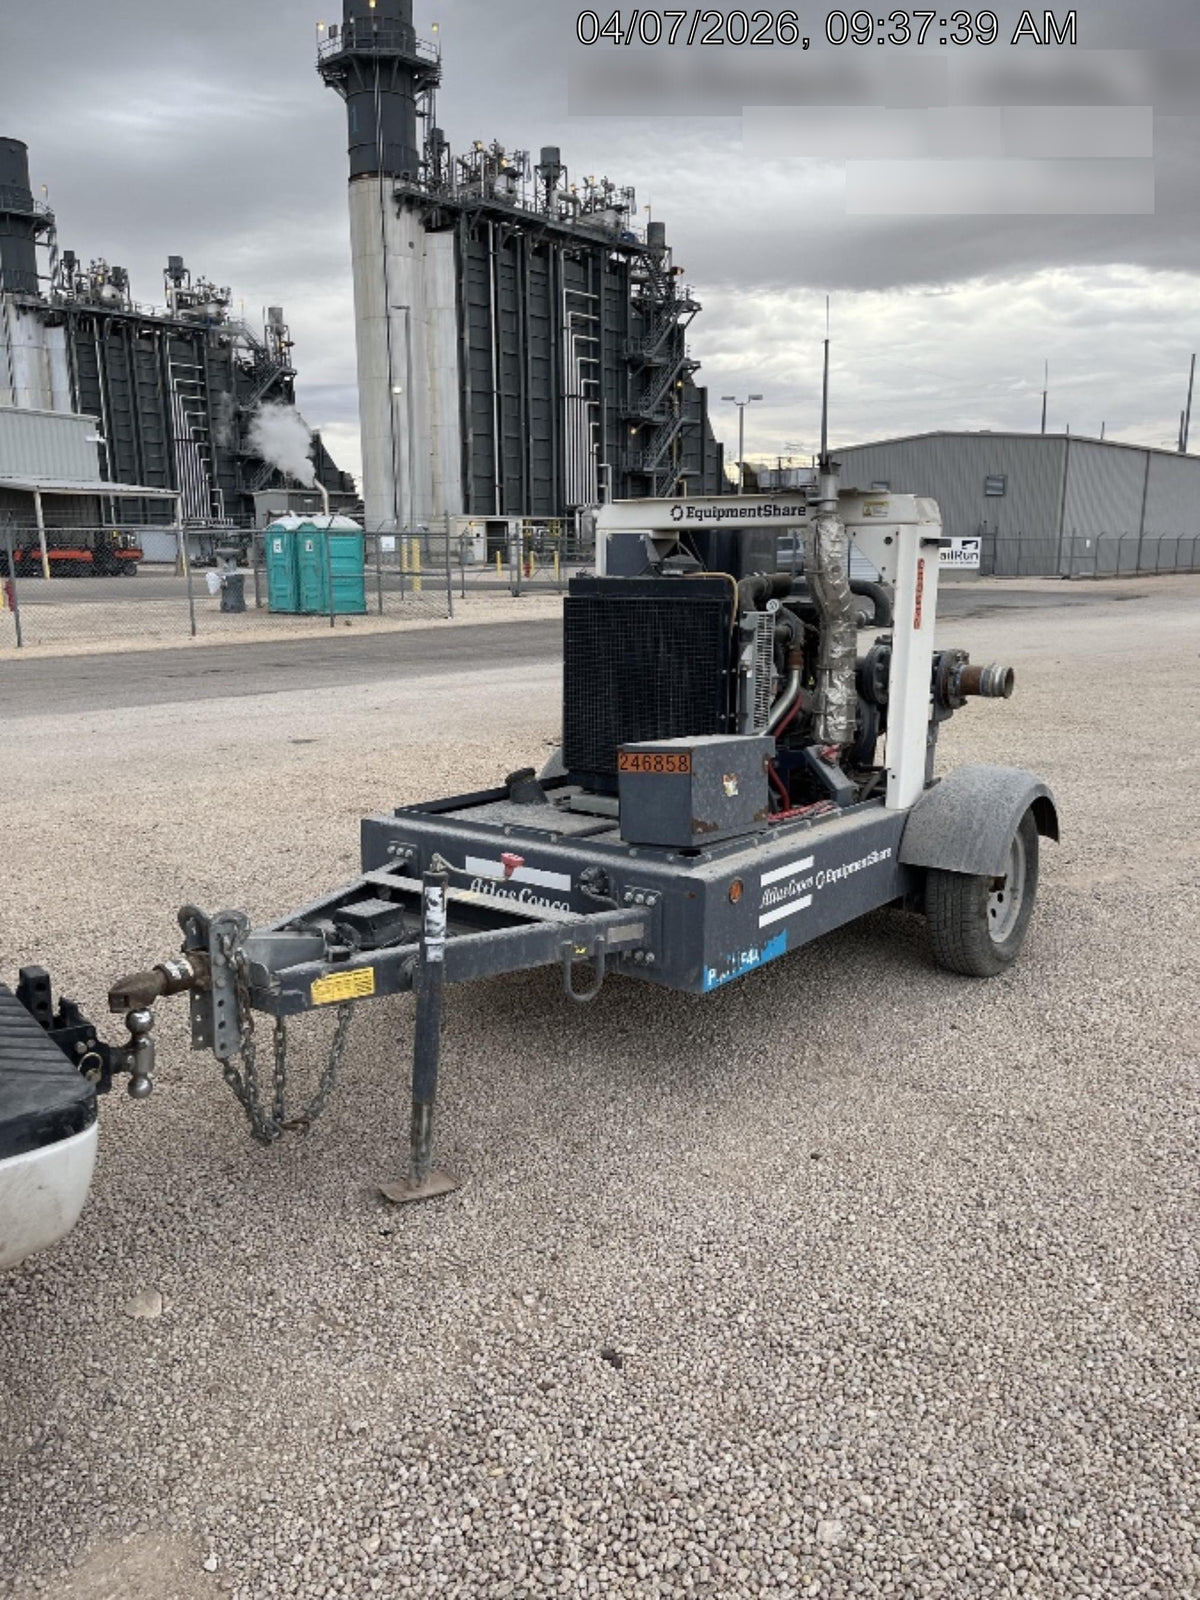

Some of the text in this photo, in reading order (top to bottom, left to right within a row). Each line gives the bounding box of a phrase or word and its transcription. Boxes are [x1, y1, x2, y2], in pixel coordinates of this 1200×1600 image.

[686, 504, 806, 521] EquipmentShare
[940, 550, 979, 561] ailRun
[620, 755, 689, 773] 246858
